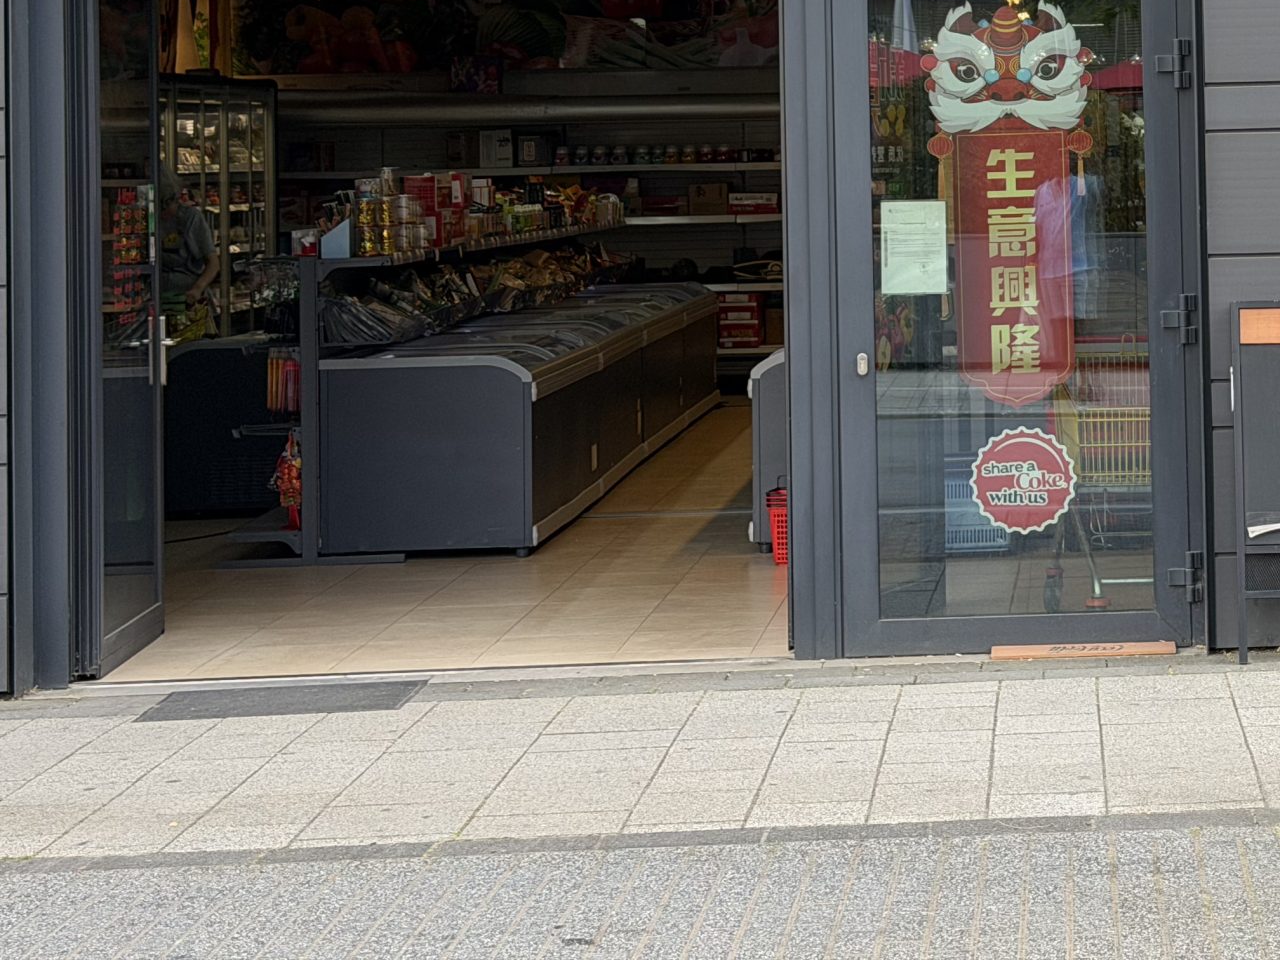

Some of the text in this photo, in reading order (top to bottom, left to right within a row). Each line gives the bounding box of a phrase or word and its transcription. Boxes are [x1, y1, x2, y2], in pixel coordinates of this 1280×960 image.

[985, 148, 1041, 376] 生意興隆
[983, 462, 1036, 476] share a
[988, 488, 1047, 504] with us
